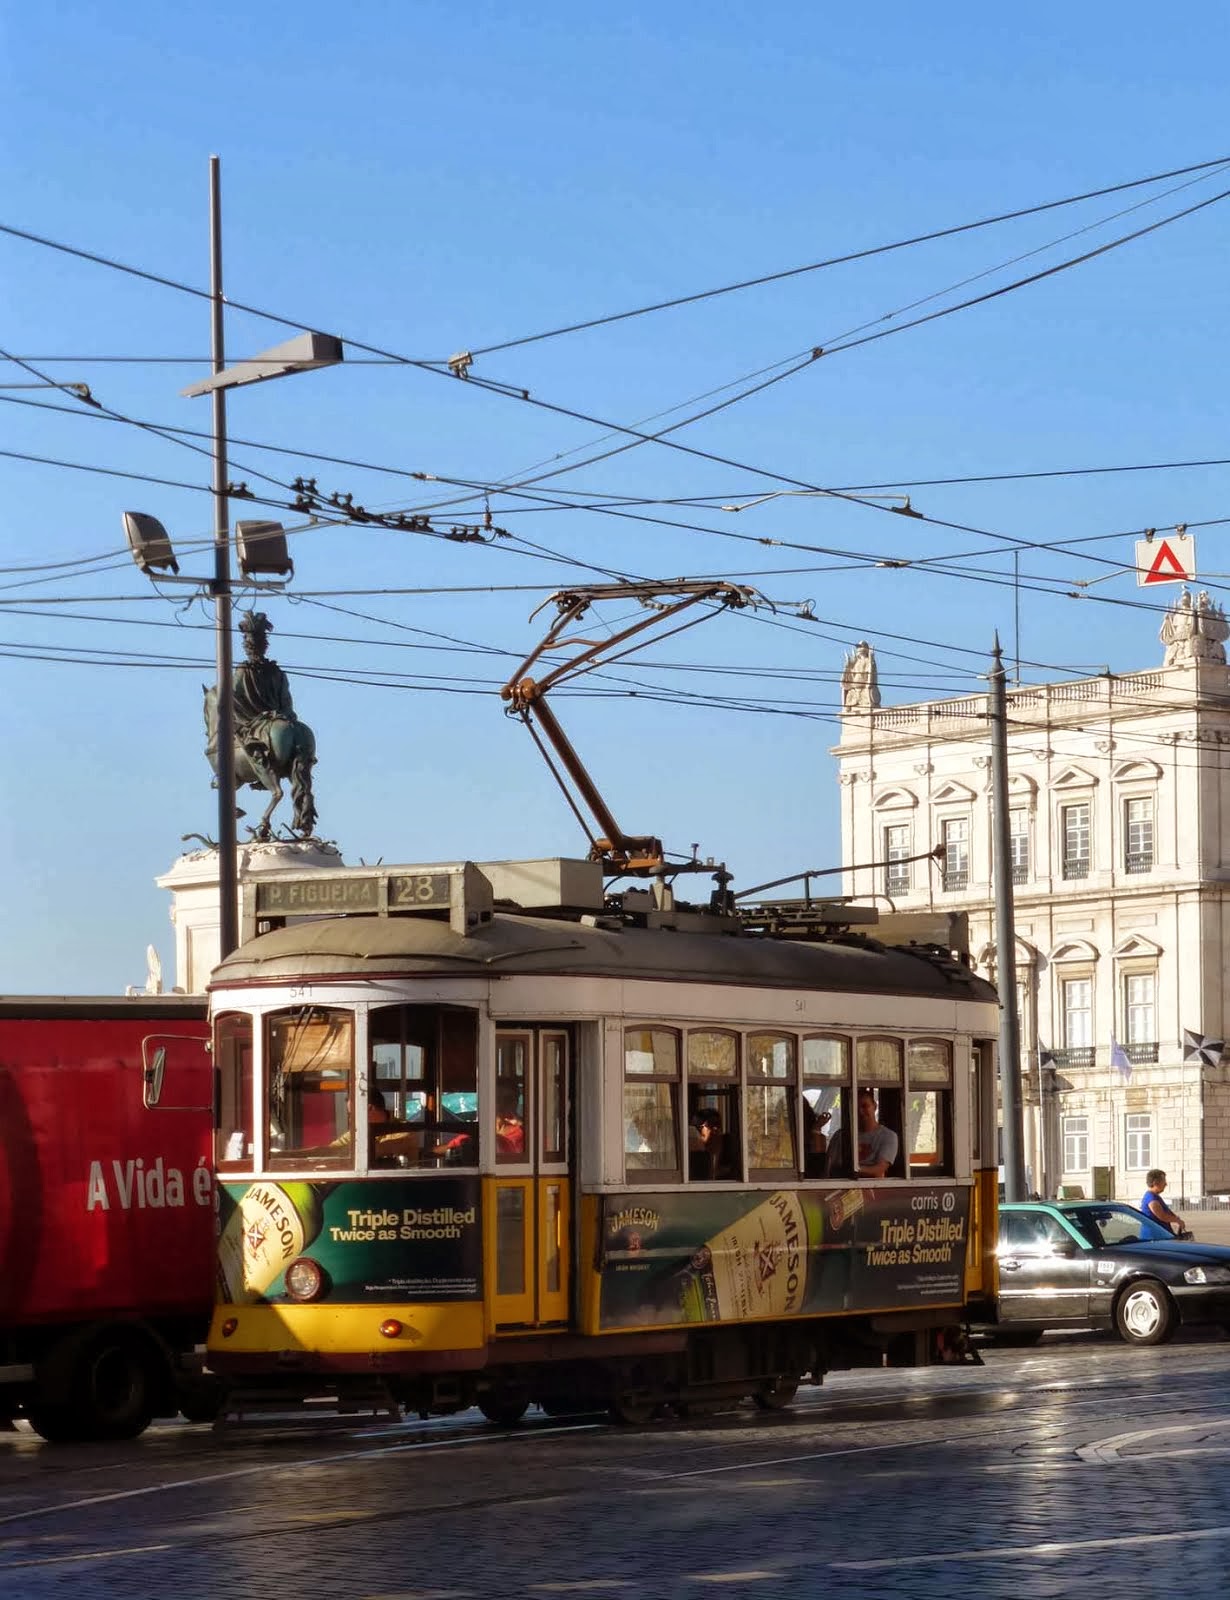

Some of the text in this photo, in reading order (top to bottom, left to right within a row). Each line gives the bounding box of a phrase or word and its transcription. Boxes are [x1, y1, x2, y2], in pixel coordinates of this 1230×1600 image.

[397, 876, 434, 902] 28
[87, 1156, 210, 1211] A Vida é
[911, 1191, 938, 1210] carris
[246, 1188, 294, 1259] JAMESON
[347, 1207, 475, 1230] Triple Distilled
[611, 1208, 660, 1233] JAMESON
[330, 1226, 375, 1241] Twice
[378, 1229, 396, 1240] as
[880, 1216, 964, 1248] Triple Distilled
[770, 1193, 799, 1313] JAMESON
[866, 1245, 897, 1266] Twice
[898, 1249, 911, 1264] as
